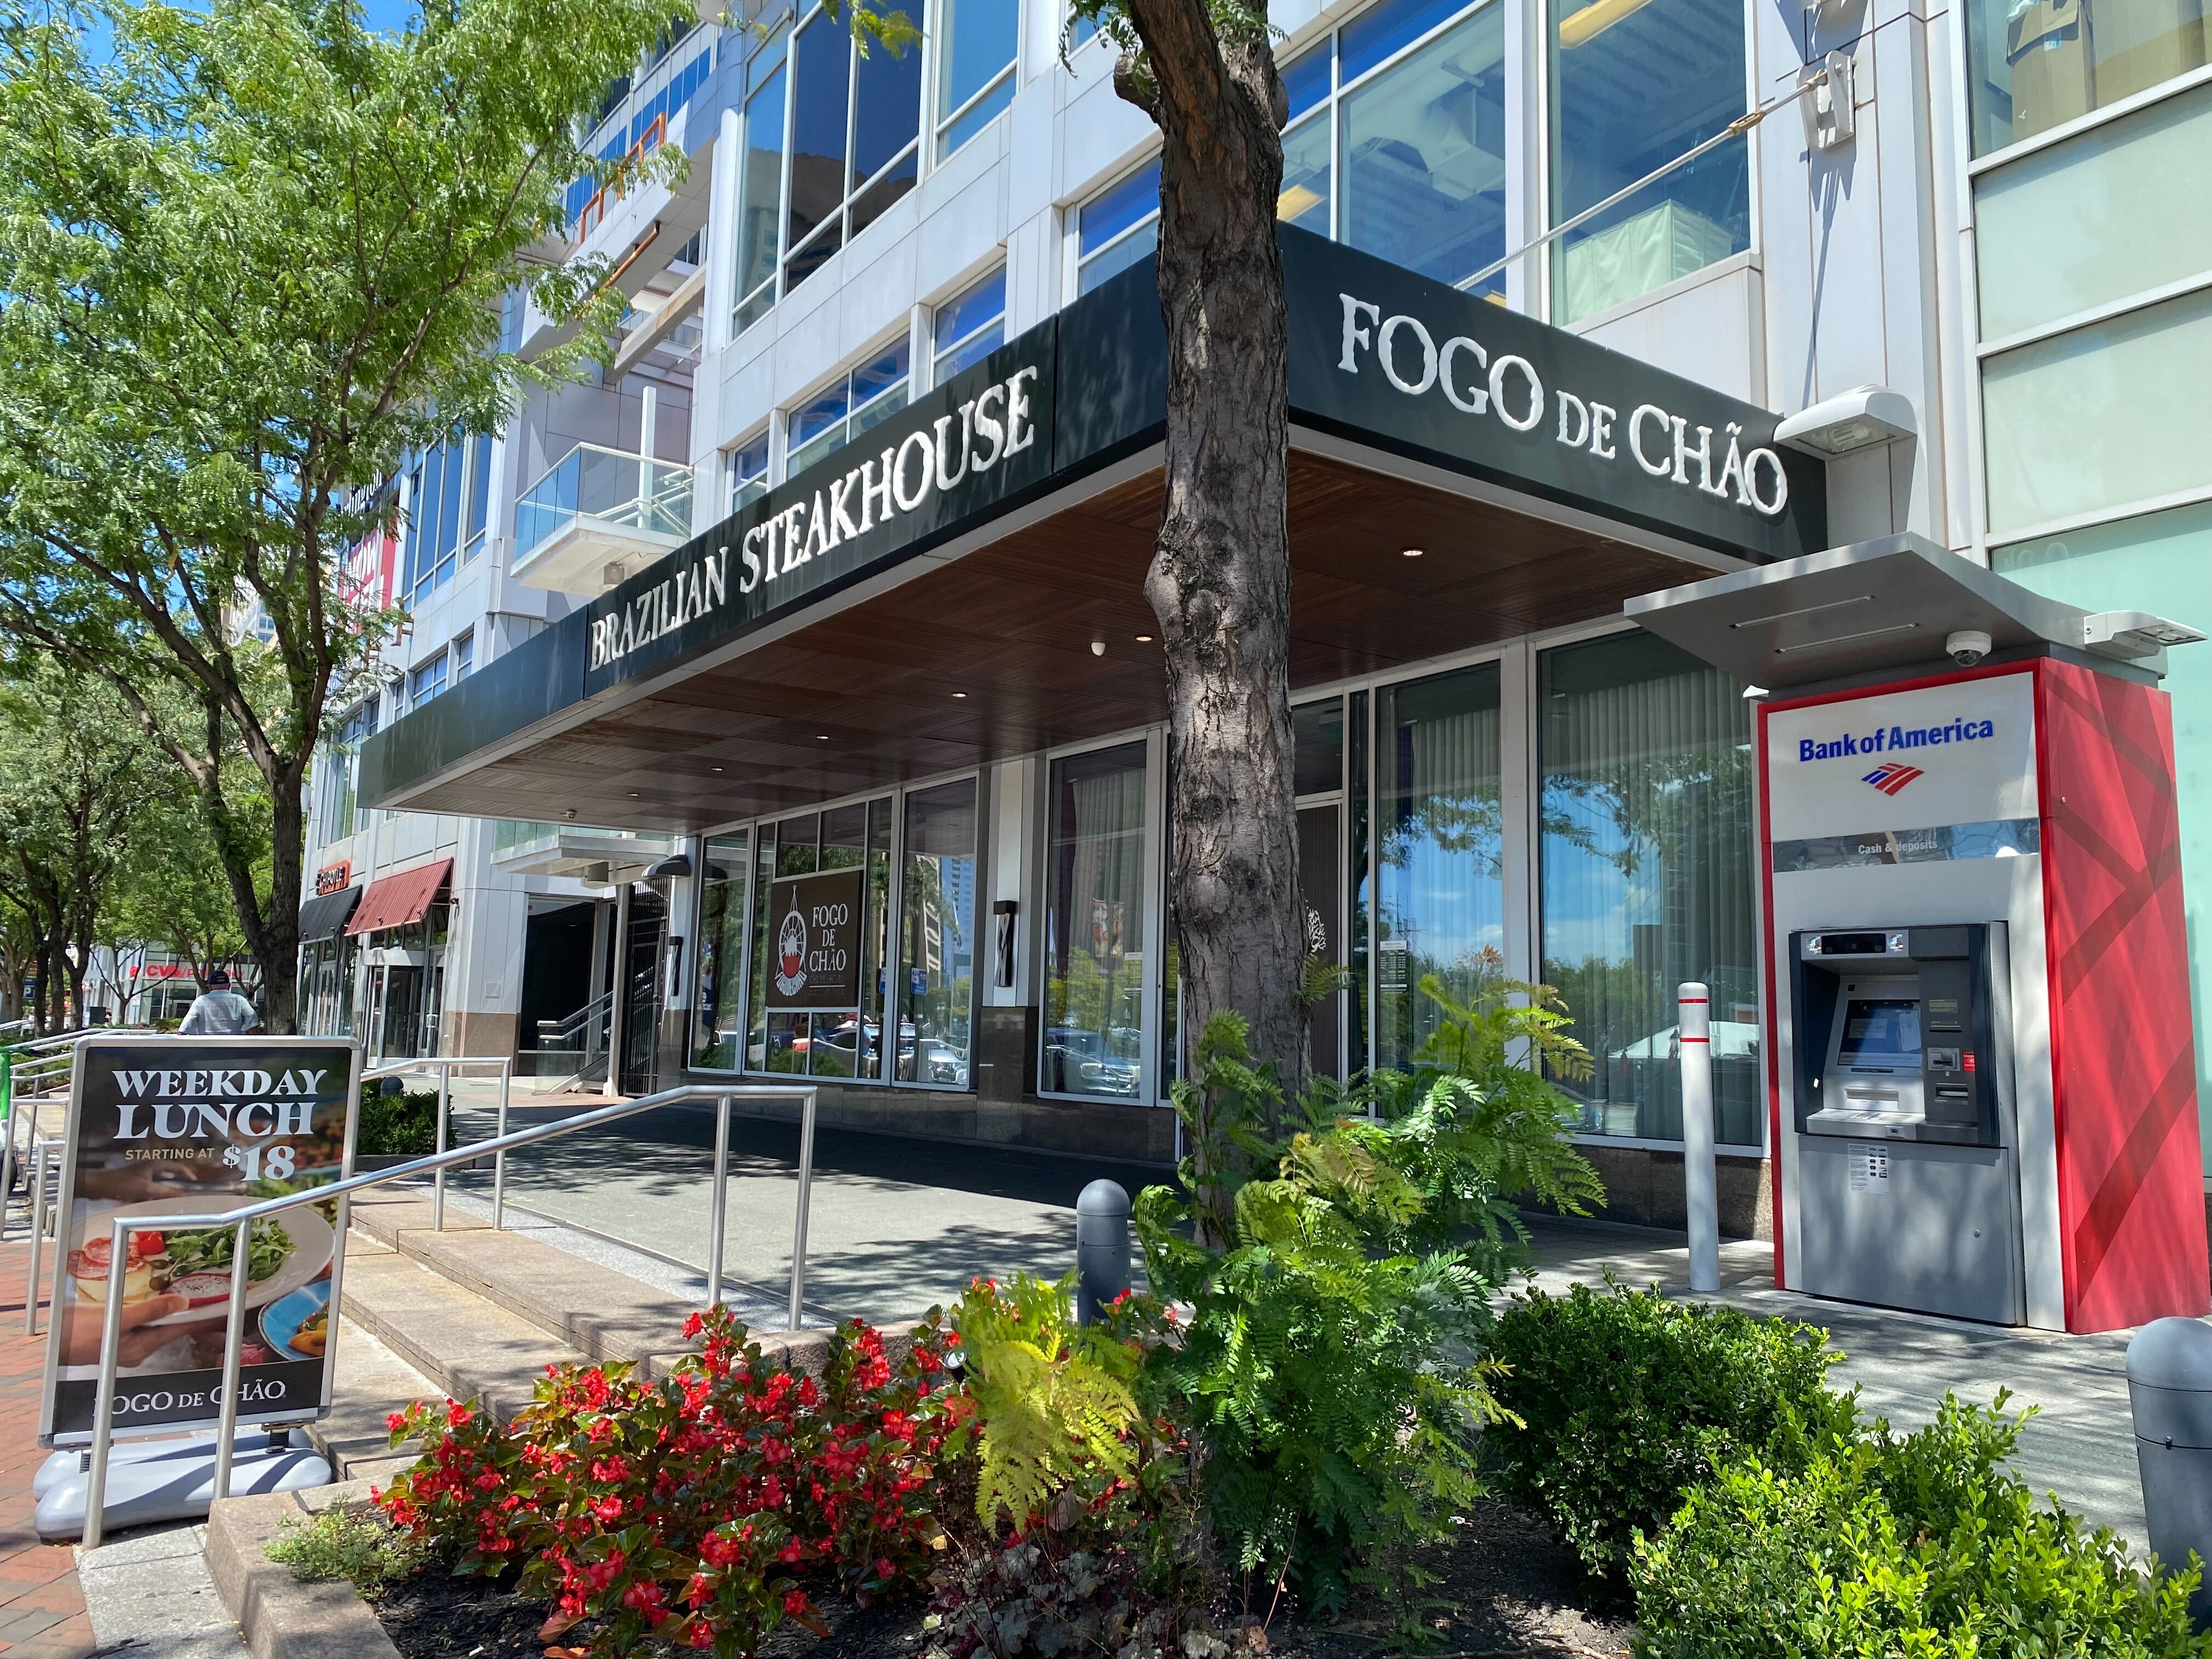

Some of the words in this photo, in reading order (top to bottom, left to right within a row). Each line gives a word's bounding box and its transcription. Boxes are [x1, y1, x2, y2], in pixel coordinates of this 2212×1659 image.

[1338, 292, 1544, 431] FOGO
[1556, 389, 1617, 459] DE
[1629, 404, 1787, 515] CHÃO
[589, 546, 729, 672] BRAZILIAN
[739, 365, 1038, 594] STEAKHOUSE
[1799, 733, 1857, 761] Bank
[1860, 728, 1884, 753] of
[1888, 718, 1994, 751] America
[1858, 844, 1882, 854] Cash
[1896, 839, 1938, 852] deposits
[812, 903, 848, 927] FOGO
[822, 929, 836, 947] DE
[809, 949, 847, 972] CHÃO
[23, 987, 31, 997] P
[111, 1069, 327, 1097] WEEKDAY
[112, 1102, 314, 1139] LUNCH
[125, 1148, 194, 1160] STARTING
[197, 1148, 215, 1159] AT
[222, 1143, 295, 1181] $18
[92, 1391, 173, 1417] OGO
[177, 1392, 205, 1408] DE
